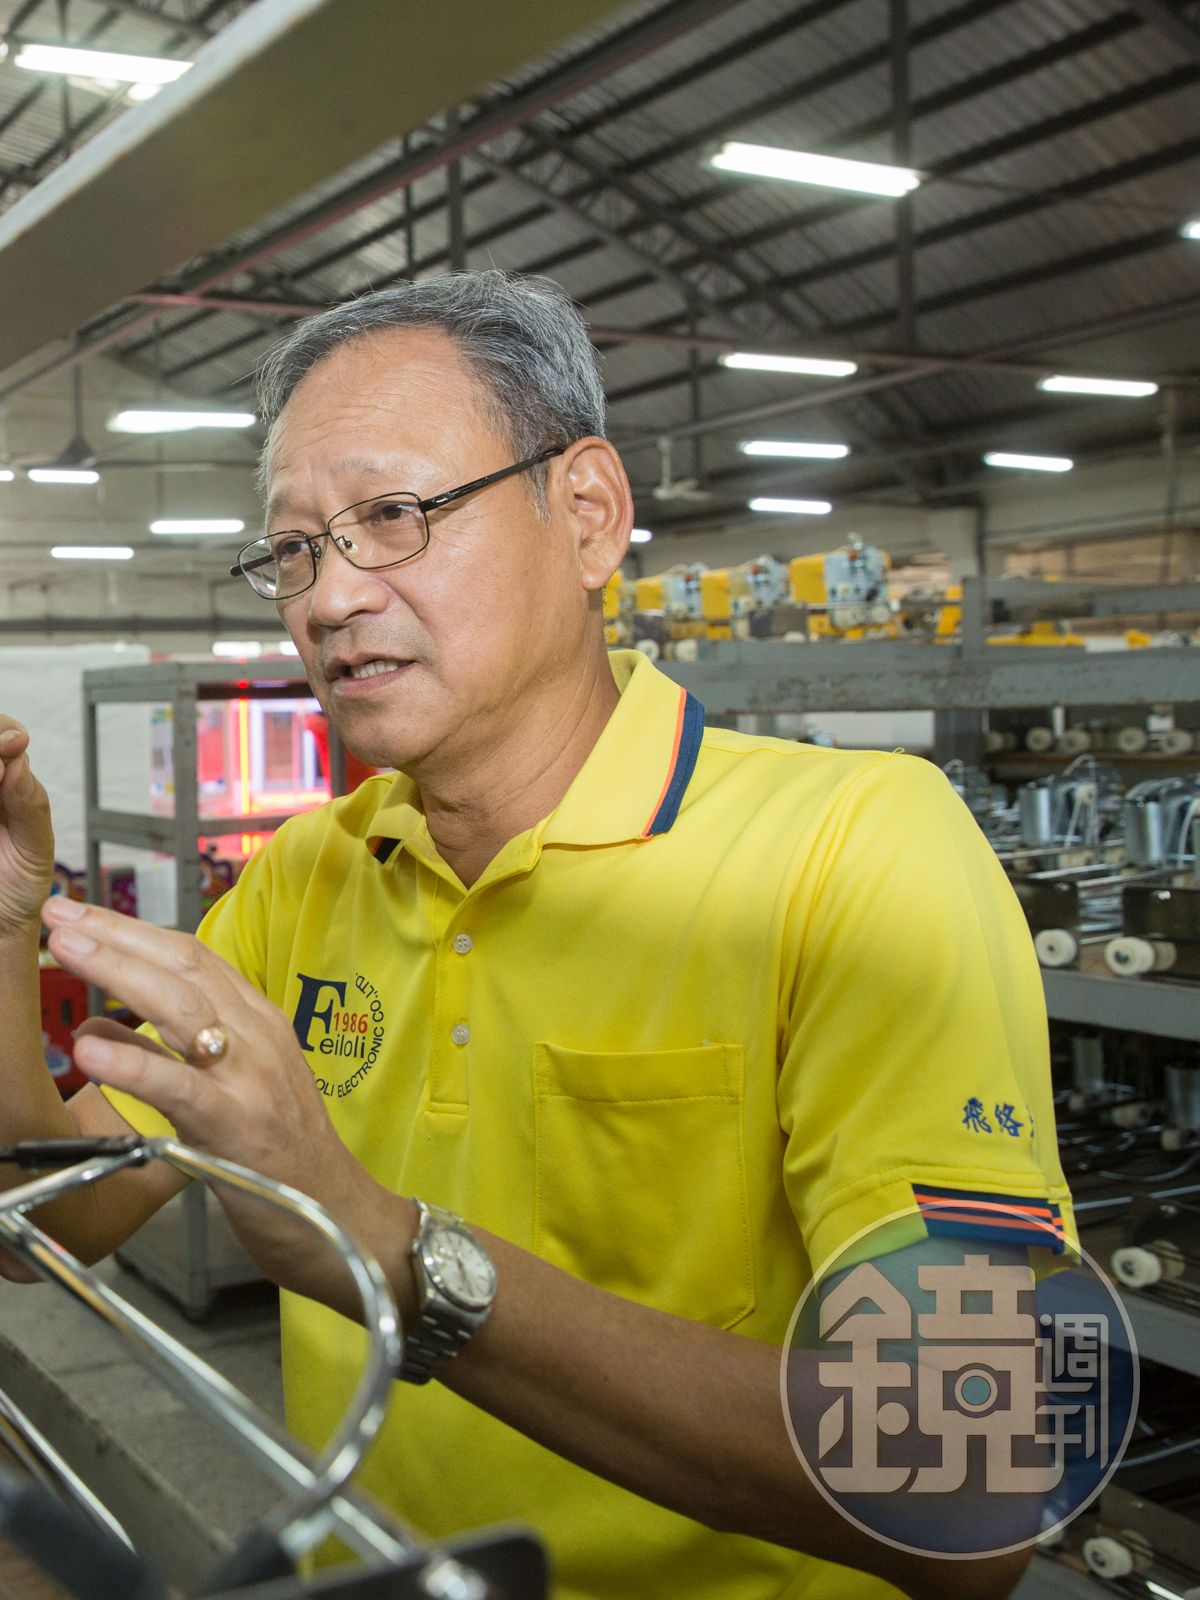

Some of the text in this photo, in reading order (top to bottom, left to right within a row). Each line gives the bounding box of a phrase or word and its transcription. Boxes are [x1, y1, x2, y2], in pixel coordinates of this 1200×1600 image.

[333, 1012, 369, 1034] 1986
[337, 1027, 384, 1098] ELECTRONIC
[962, 1097, 1034, 1137] 飛絡
